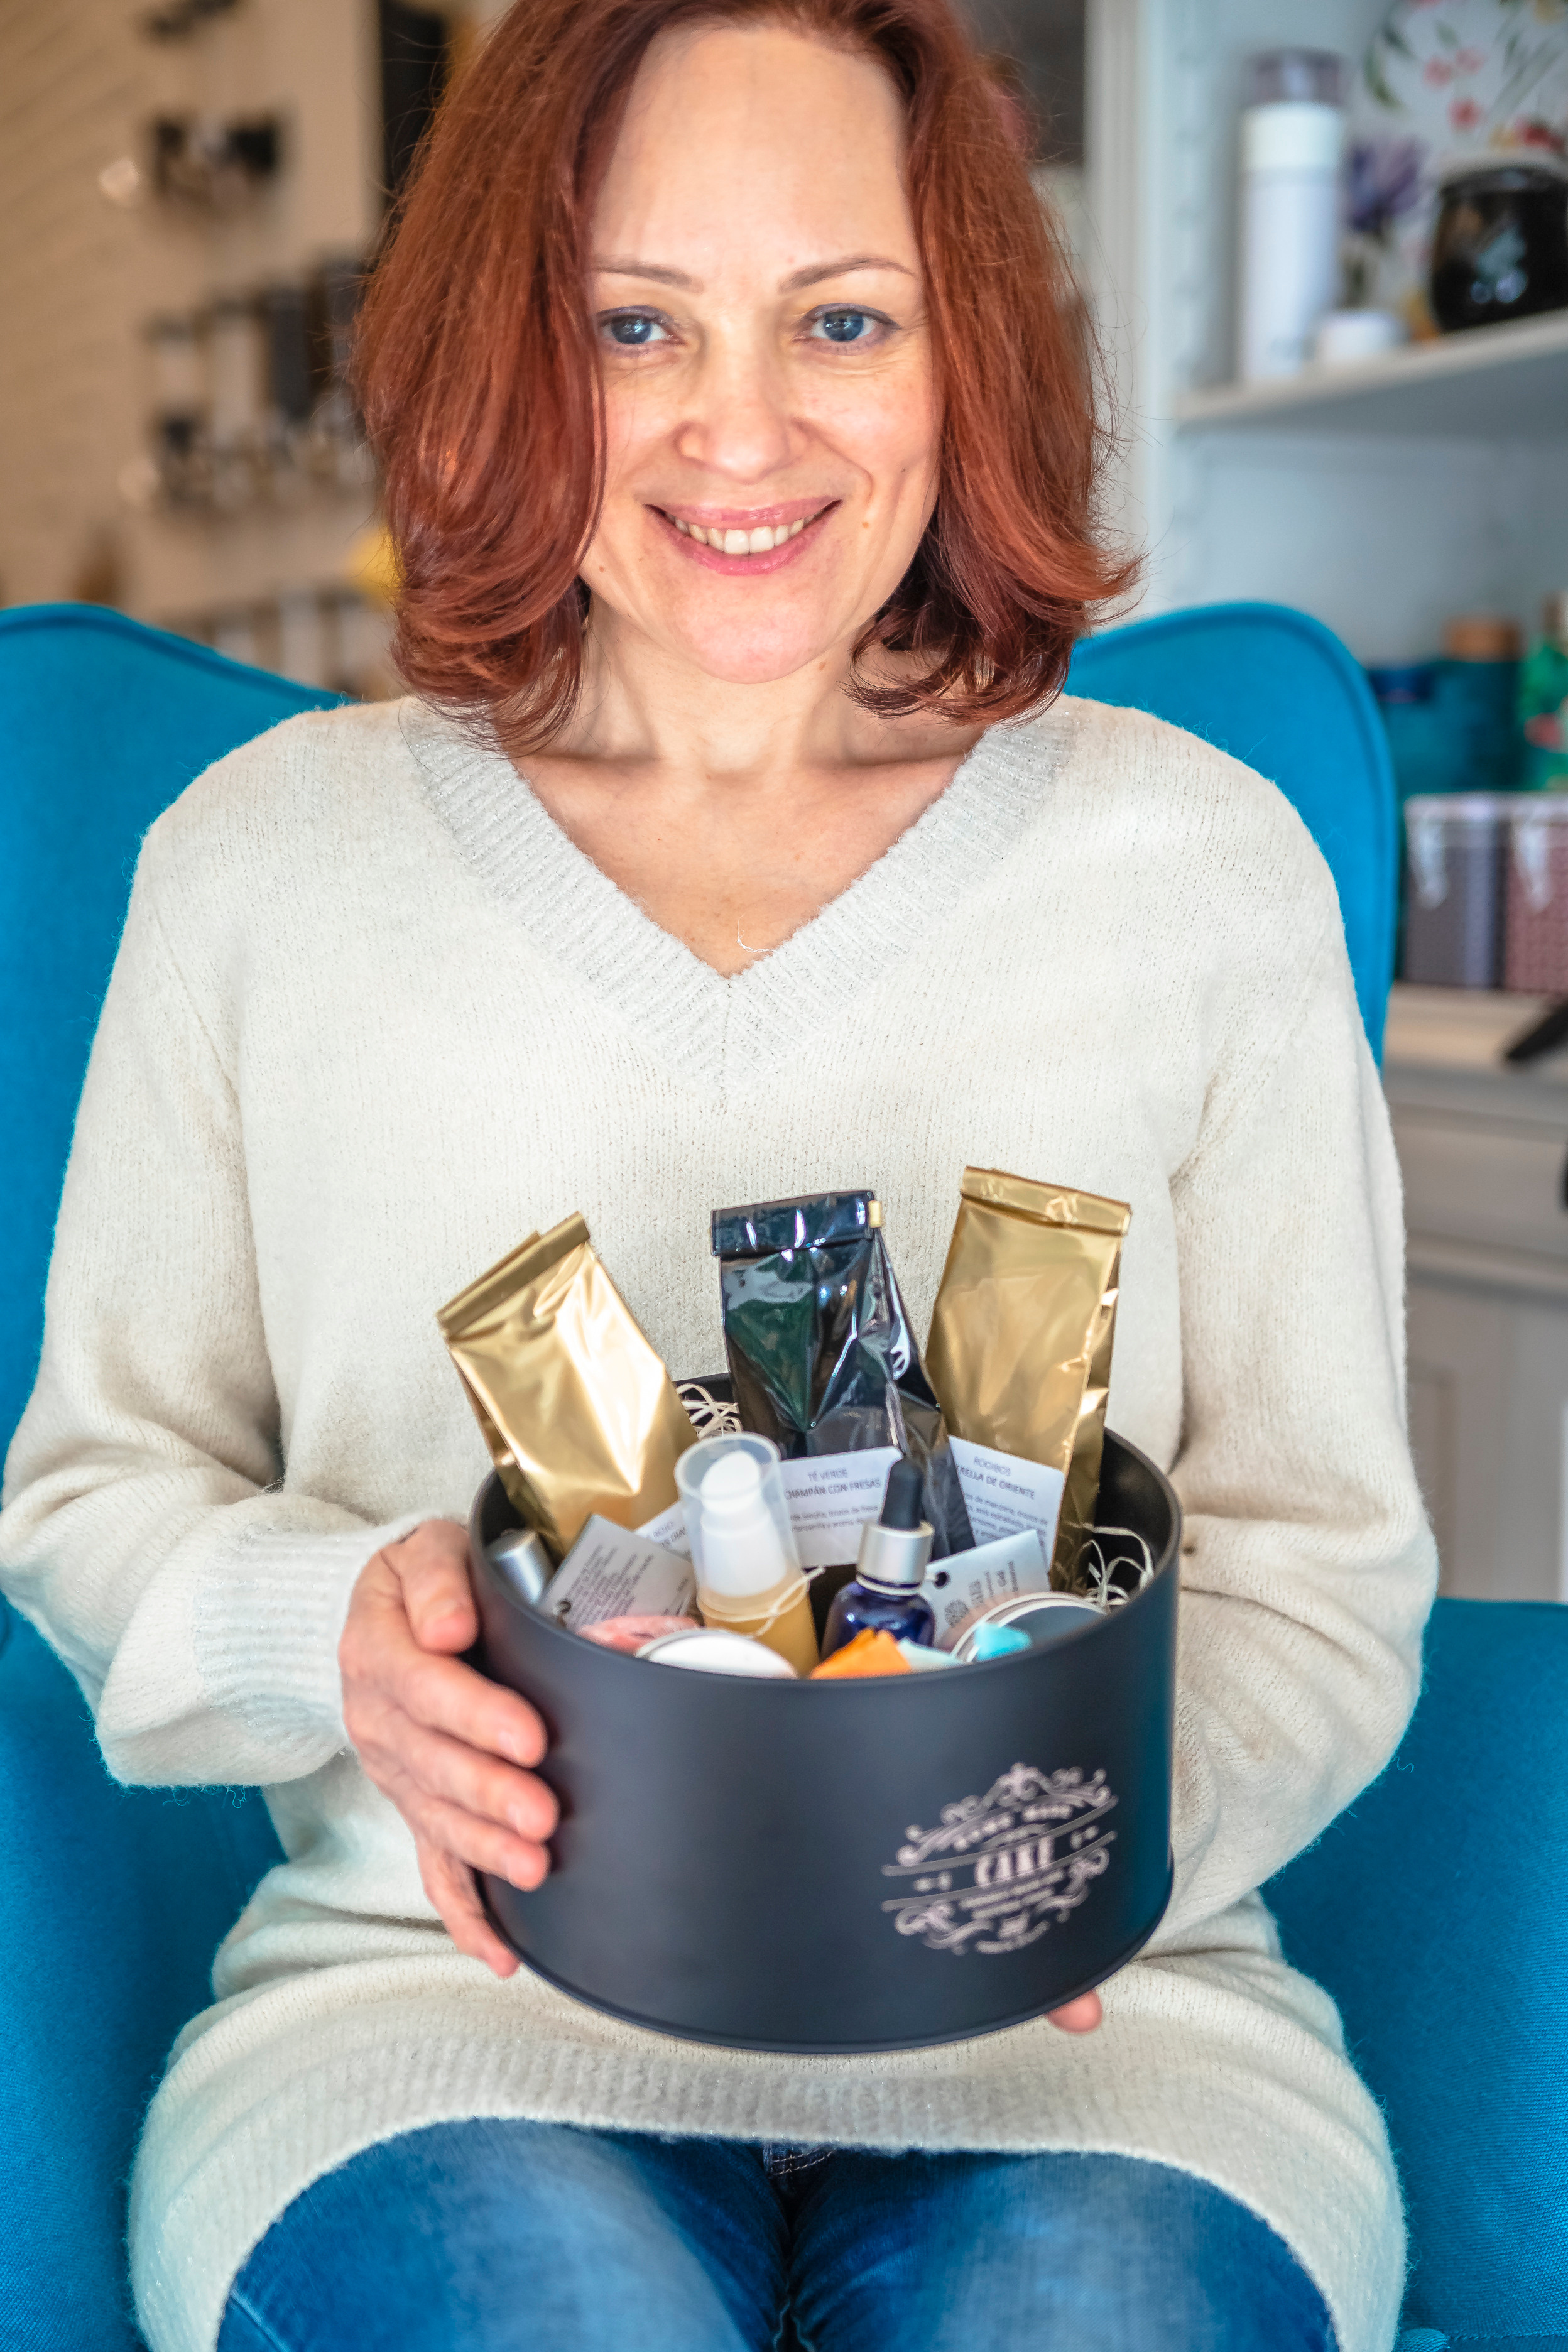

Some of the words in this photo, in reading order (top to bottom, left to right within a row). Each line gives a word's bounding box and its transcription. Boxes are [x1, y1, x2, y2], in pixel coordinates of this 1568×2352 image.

[808, 1469, 818, 1482] TÉ
[820, 1467, 847, 1481] VERDE
[974, 1457, 1011, 1477] ROOIBOS
[784, 1485, 826, 1500] CHAMPÁN
[828, 1483, 847, 1495] CON
[849, 1478, 881, 1491] FRESAS
[956, 1465, 984, 1481] TRELLA
[986, 1475, 997, 1487] DE
[999, 1481, 1035, 1500] ORIENTE
[653, 1521, 673, 1537] ROJO
